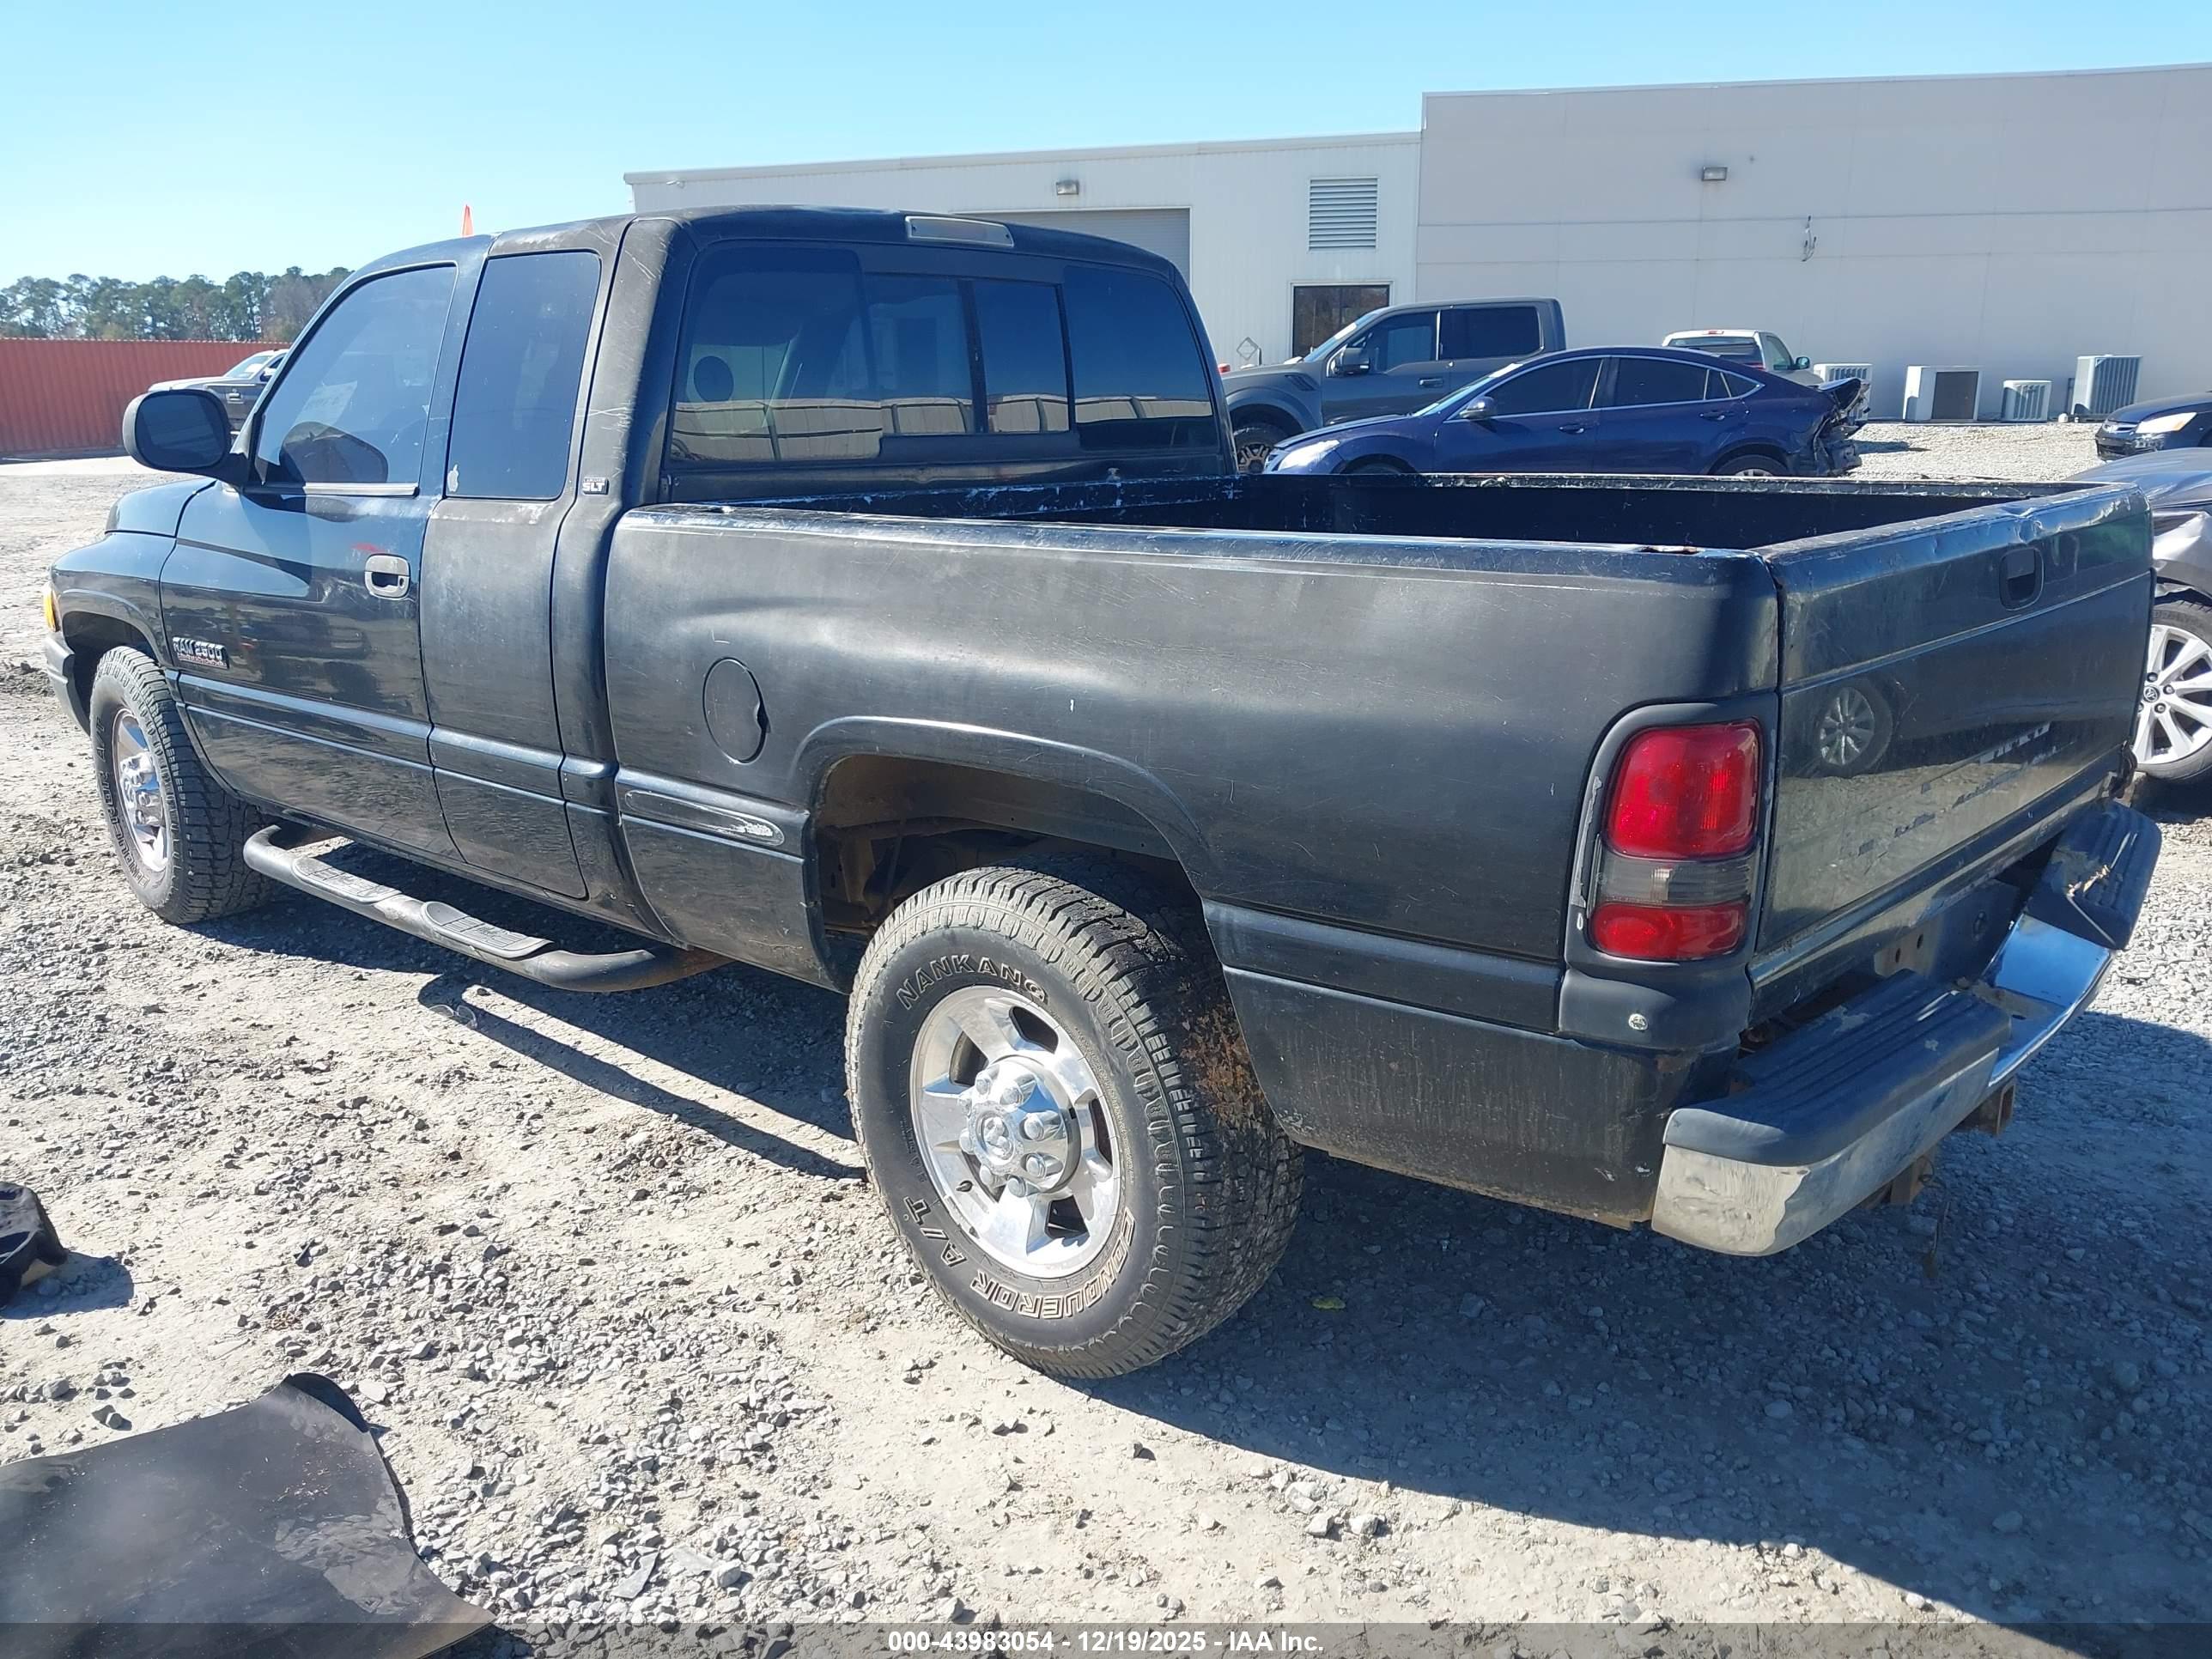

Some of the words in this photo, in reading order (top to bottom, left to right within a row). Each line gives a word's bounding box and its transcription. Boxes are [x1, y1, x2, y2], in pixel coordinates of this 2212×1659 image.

[582, 481, 605, 492] SLT
[173, 636, 194, 656] RAM
[195, 641, 224, 660] 2500
[896, 953, 1047, 1011] NANKANG
[969, 1208, 1135, 1320] CONQUEROR
